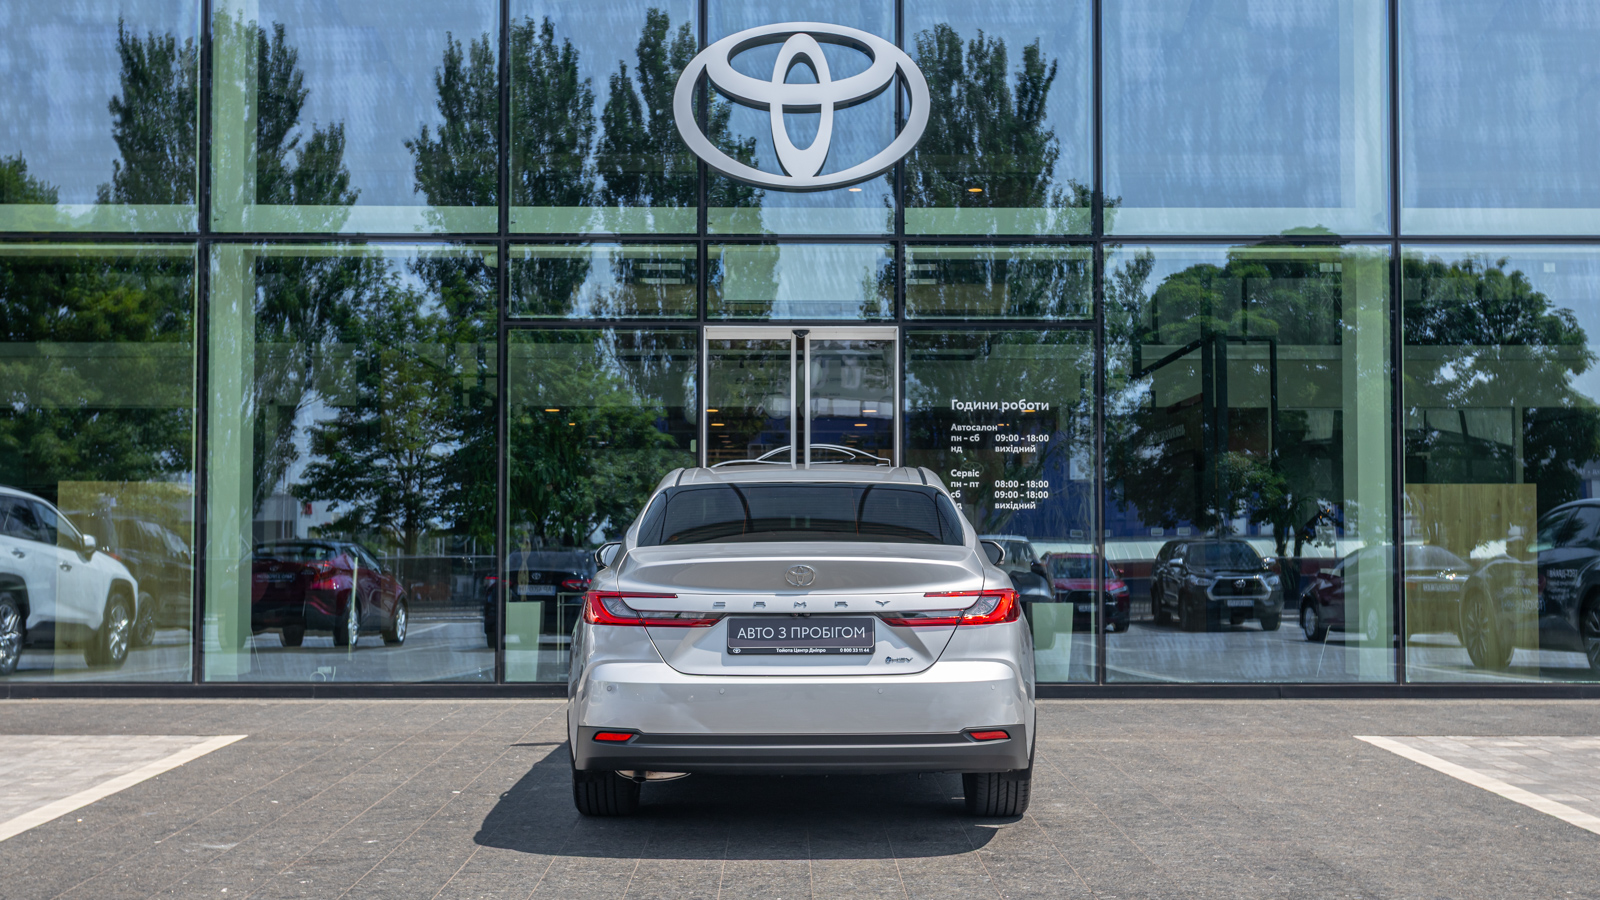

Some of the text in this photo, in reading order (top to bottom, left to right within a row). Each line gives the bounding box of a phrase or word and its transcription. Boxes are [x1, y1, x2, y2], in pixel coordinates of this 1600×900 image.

[951, 399, 1049, 412] Години роботи
[995, 445, 1036, 453] вихідний
[951, 469, 979, 478] Сервіс
[995, 501, 1036, 510] вихідний
[713, 600, 891, 609] CAMRY
[737, 626, 865, 639] АВТО З ПРОБІГОМ
